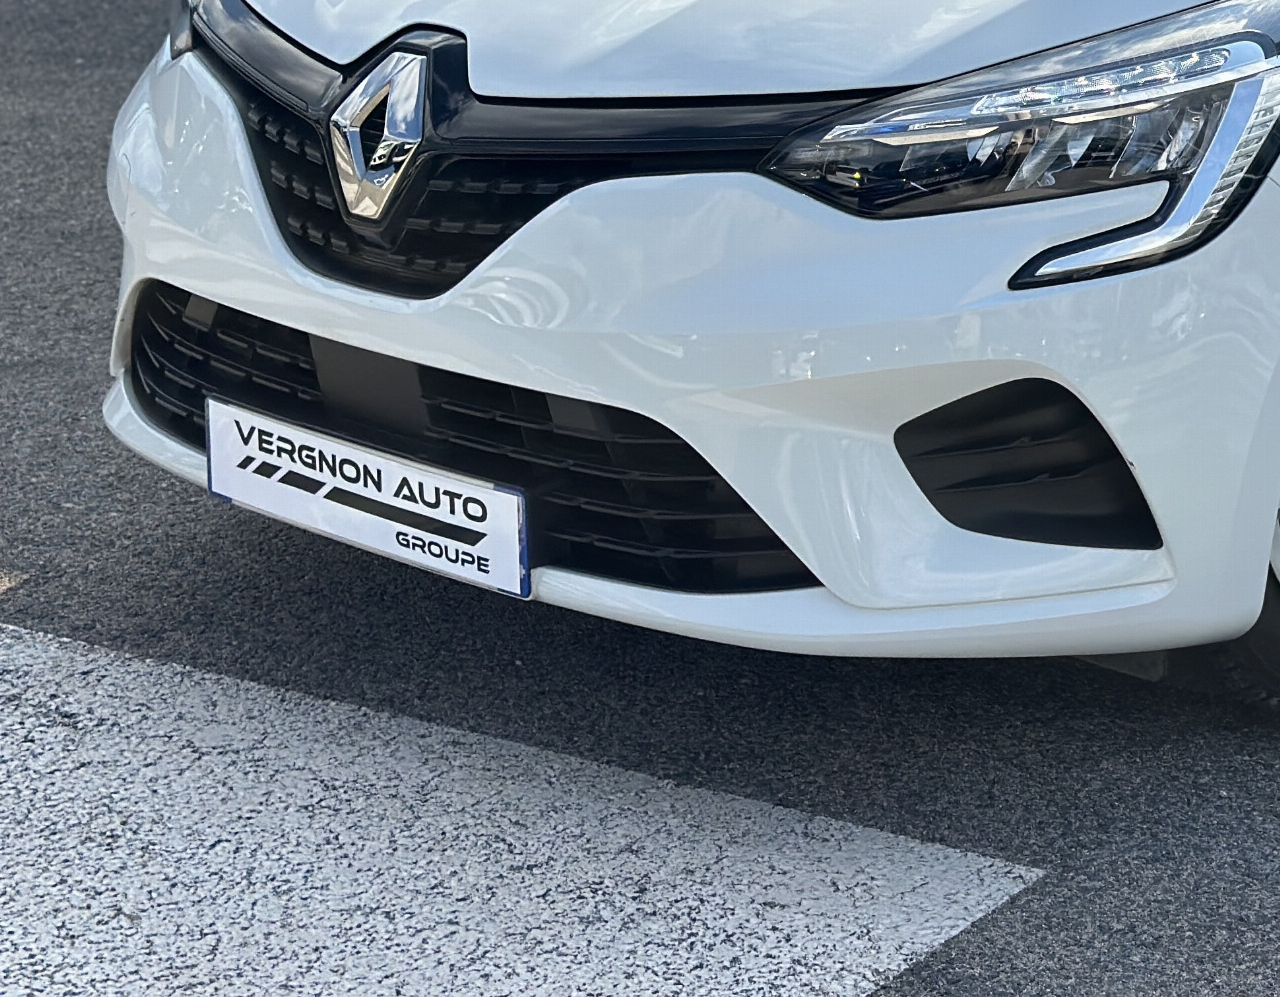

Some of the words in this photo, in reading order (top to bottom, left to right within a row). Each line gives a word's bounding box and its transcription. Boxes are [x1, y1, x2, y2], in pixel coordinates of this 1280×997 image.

[234, 419, 383, 493] VERGNON
[393, 476, 488, 523] AUTO
[395, 531, 490, 574] GROUPE
